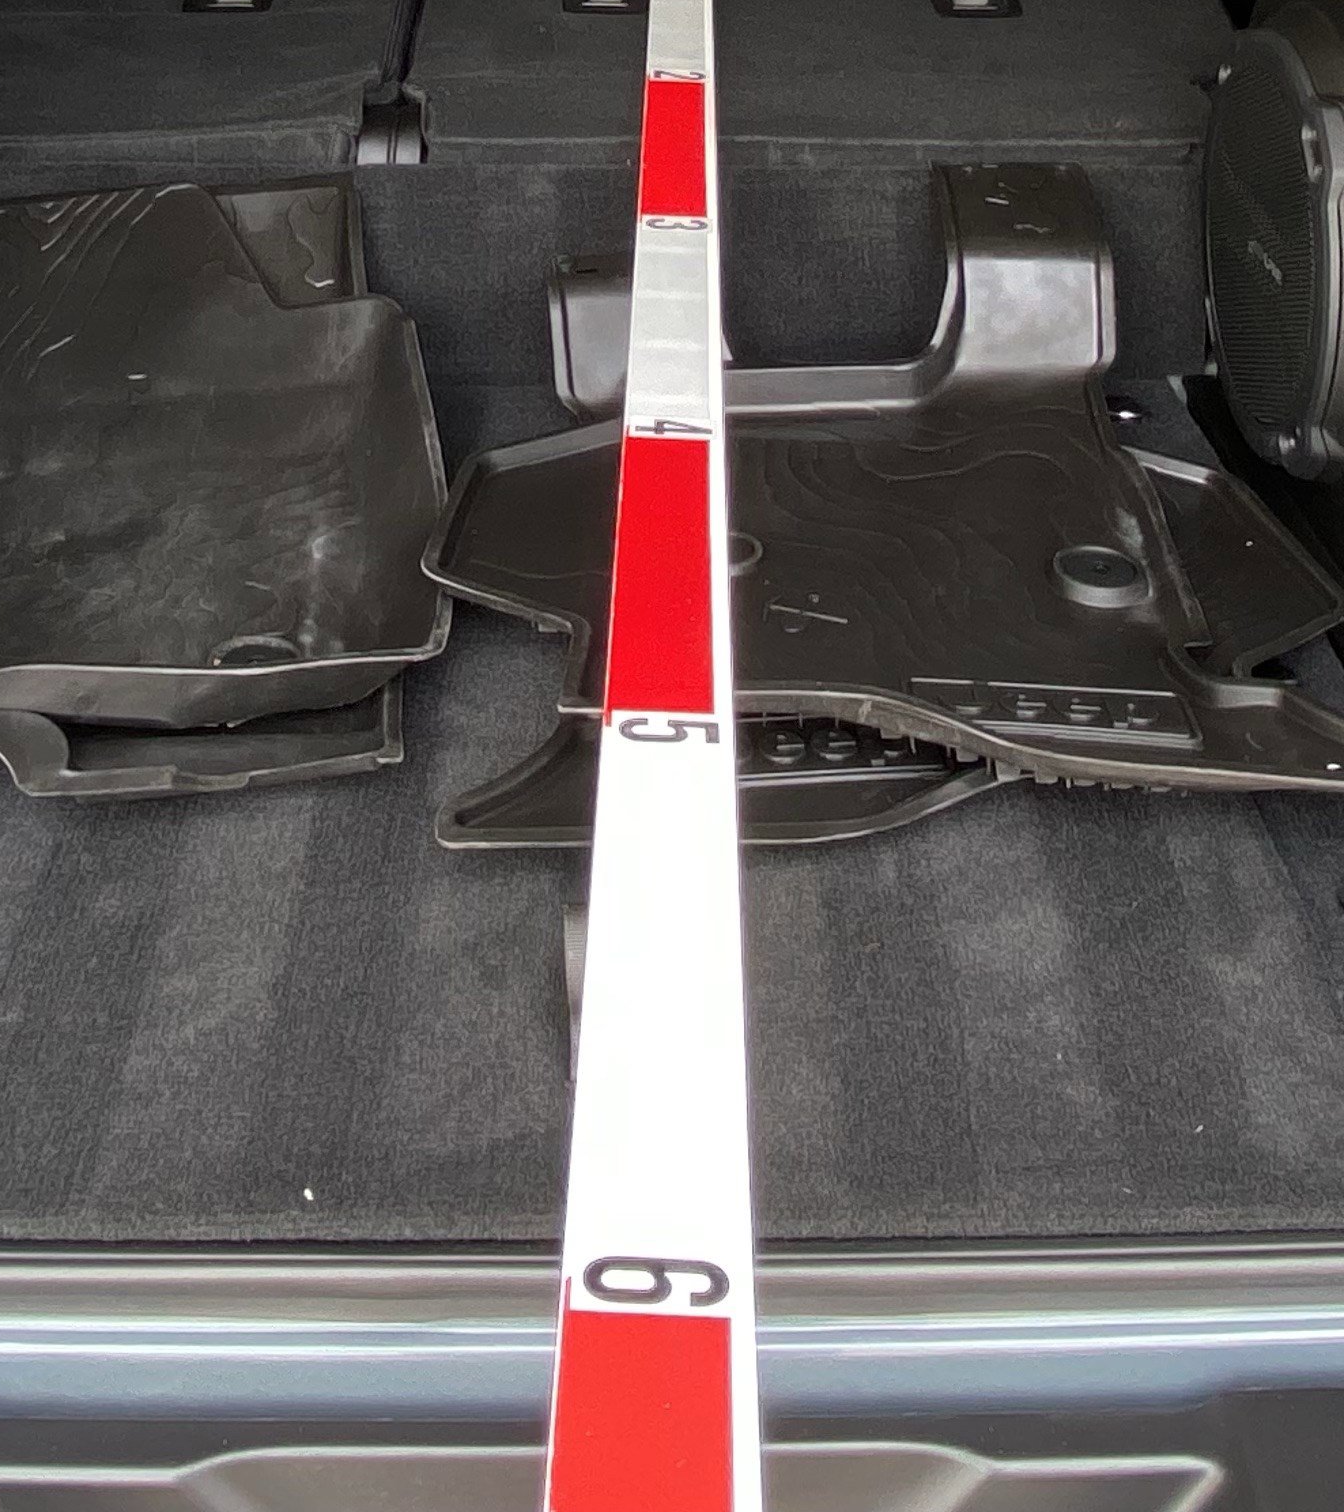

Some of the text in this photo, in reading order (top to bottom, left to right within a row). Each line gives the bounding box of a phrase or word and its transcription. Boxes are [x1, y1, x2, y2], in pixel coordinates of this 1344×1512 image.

[653, 69, 706, 80] 2
[645, 217, 707, 231] 3
[634, 419, 713, 435] 4
[619, 717, 720, 744] 5
[583, 1255, 730, 1307] 6
